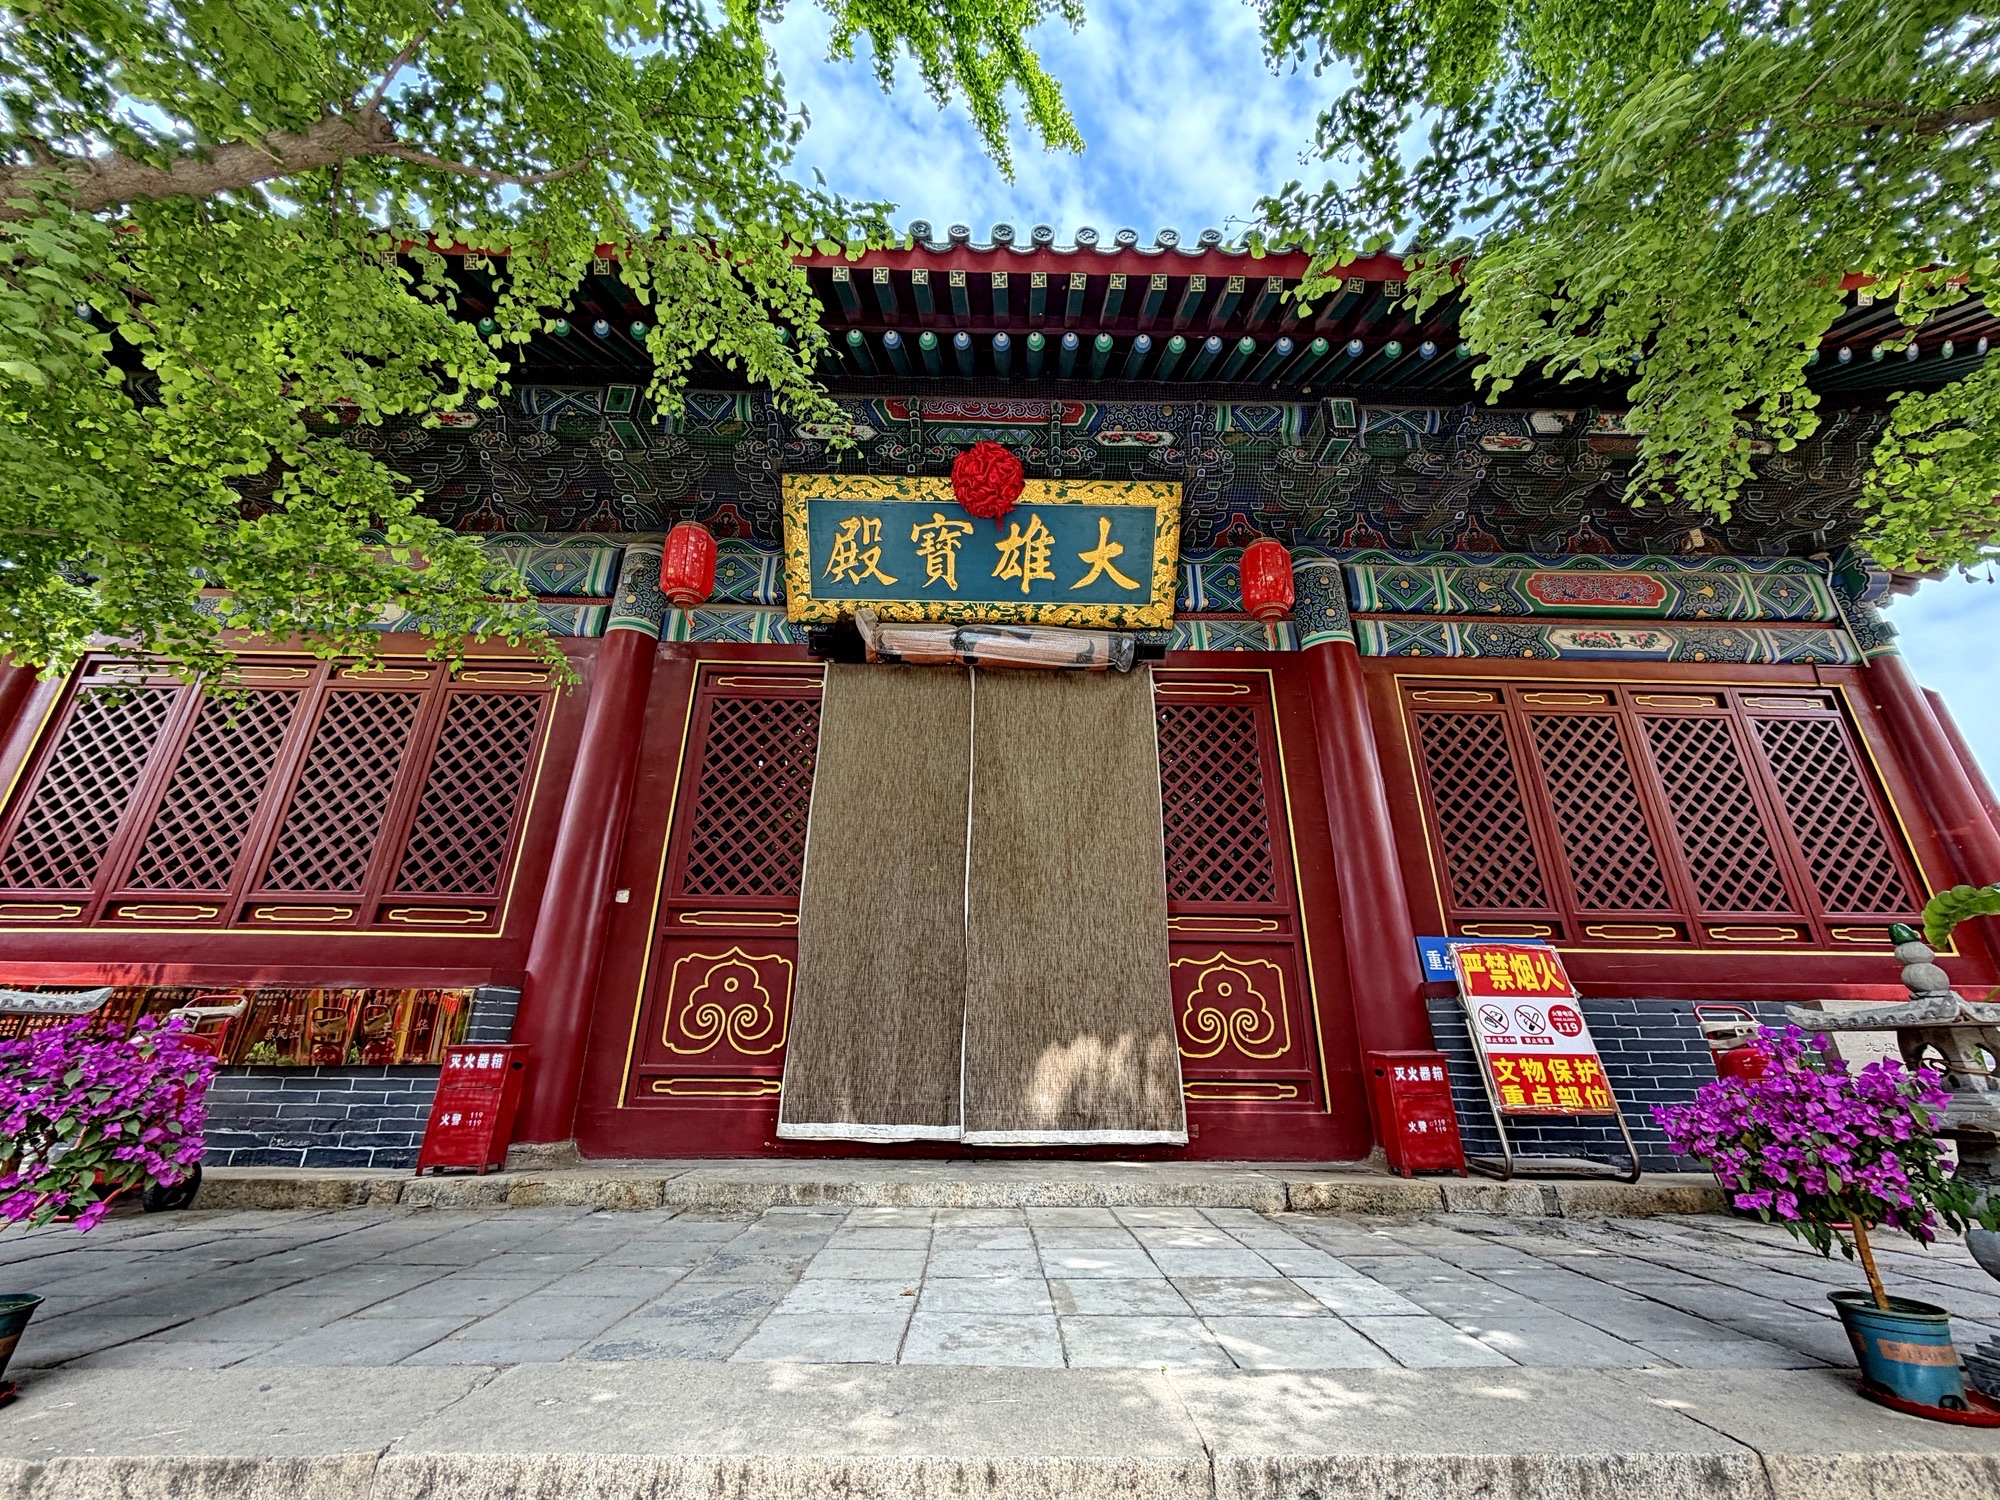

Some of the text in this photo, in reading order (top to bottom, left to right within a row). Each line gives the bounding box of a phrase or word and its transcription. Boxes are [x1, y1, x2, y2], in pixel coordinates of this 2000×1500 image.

[1459, 952, 1566, 992] 严禁烟火
[1556, 1022, 1579, 1033] 119
[449, 1053, 504, 1069] 灭火器箱
[1394, 1066, 1444, 1082] 灭火器箱
[1492, 1057, 1601, 1084] 文物保护
[1501, 1084, 1613, 1111] 重点部位
[440, 1113, 462, 1126] 火警
[1408, 1120, 1427, 1133] 火警
